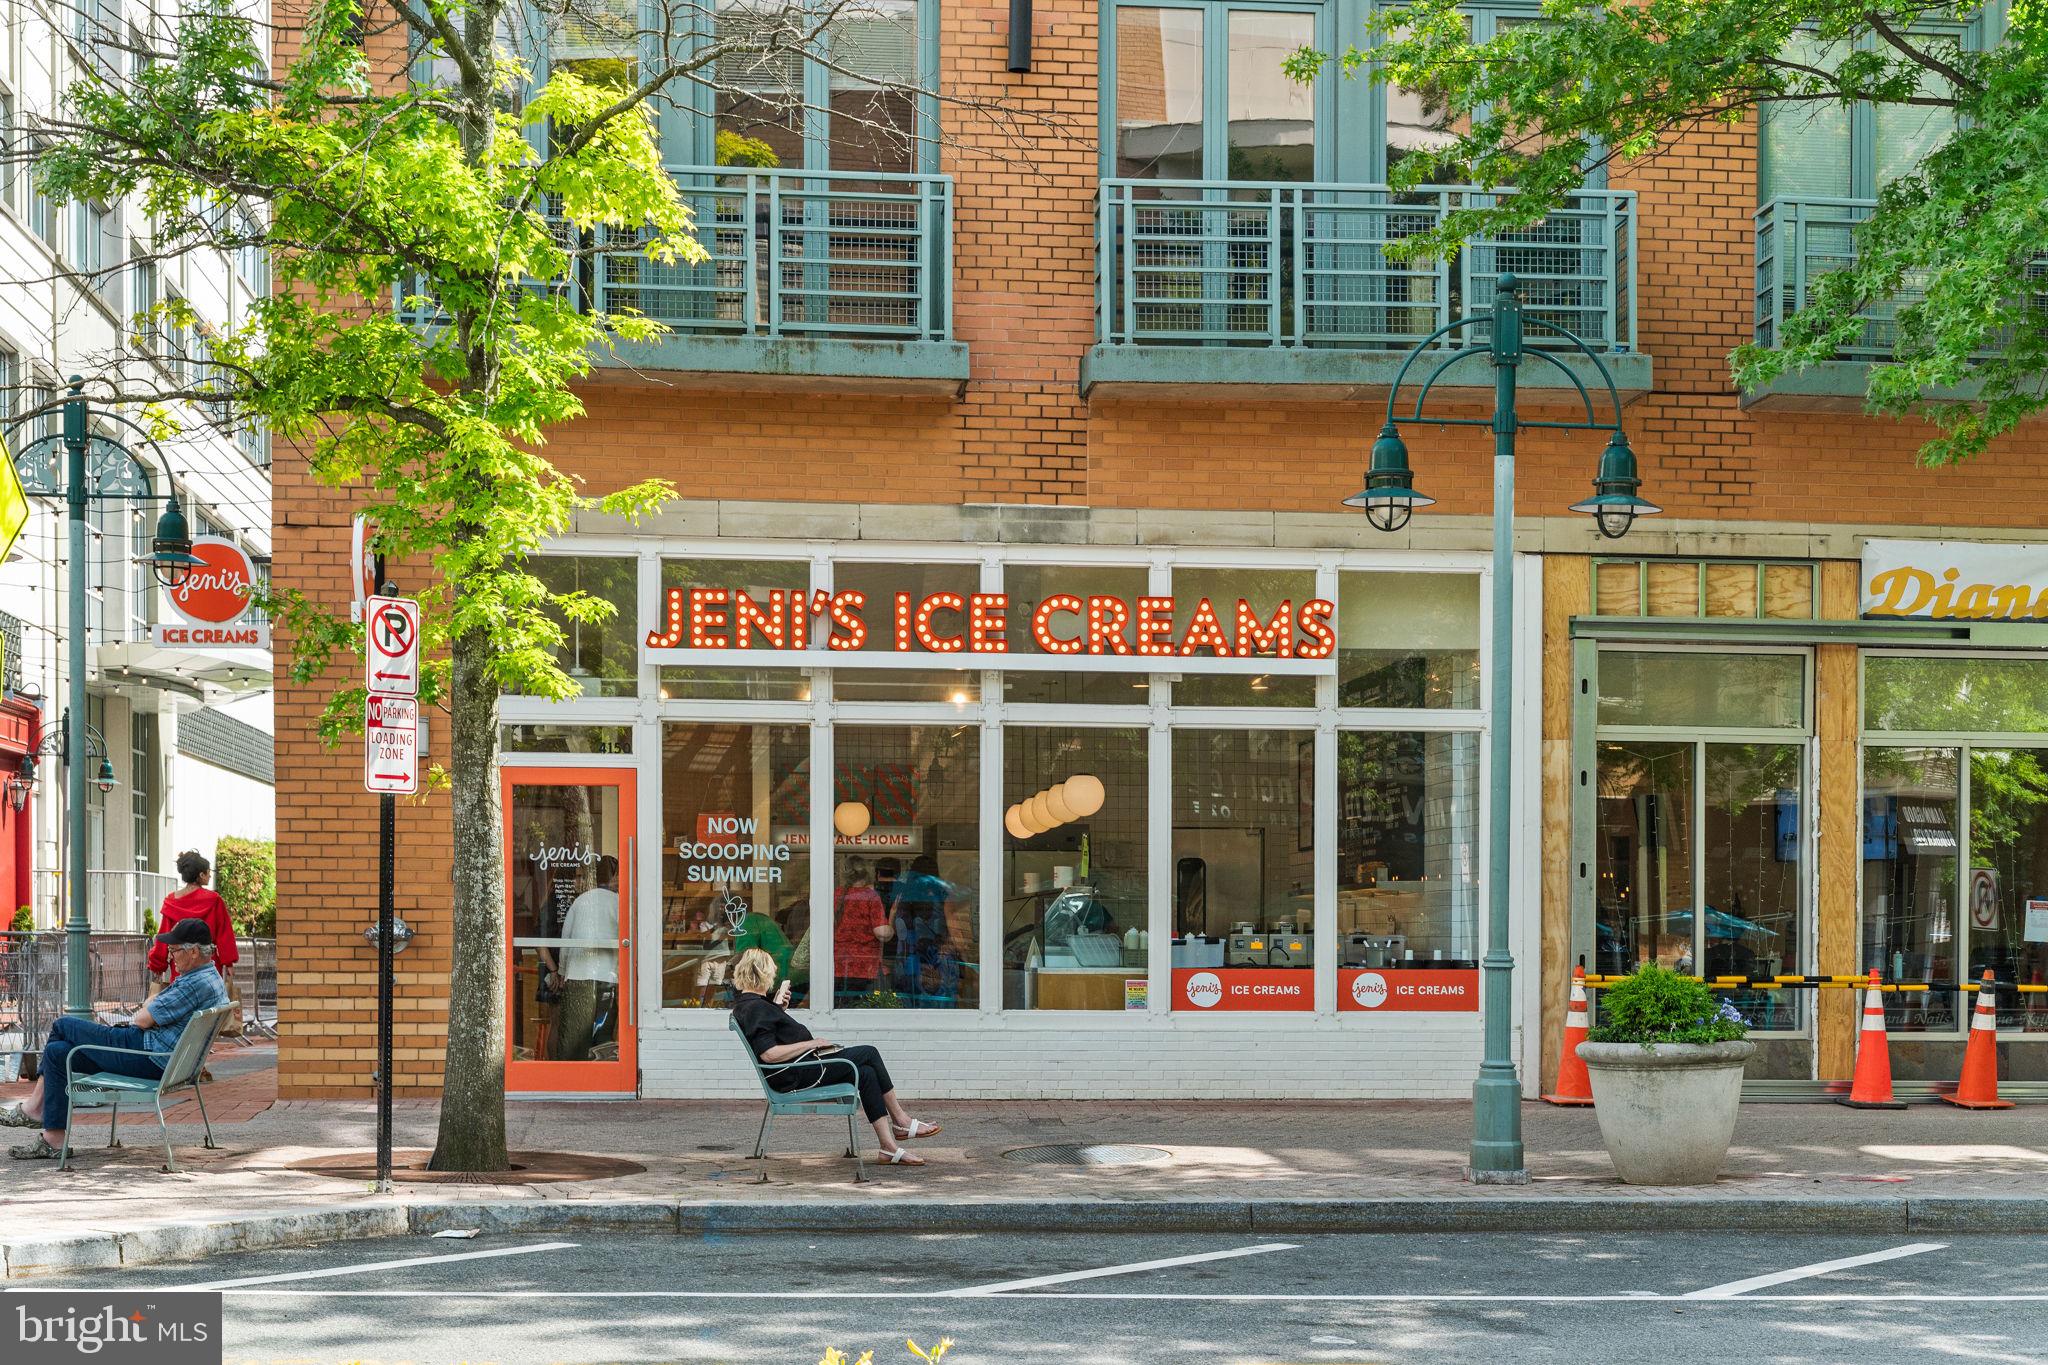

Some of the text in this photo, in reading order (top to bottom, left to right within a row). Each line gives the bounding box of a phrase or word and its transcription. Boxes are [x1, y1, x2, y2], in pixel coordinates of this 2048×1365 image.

[646, 588, 1336, 659] JENI'S ICE CREAMS
[162, 629, 259, 645] ICE CREAMS
[368, 702, 414, 721] NO PARKING
[371, 731, 413, 747] LOADING
[380, 747, 404, 761] ZONE
[600, 742, 631, 754] 4150
[707, 817, 759, 835] NOW
[782, 834, 910, 846] JEN AKE-HOME
[679, 843, 790, 861] SCOOPING
[687, 865, 782, 883] SUMMER
[1187, 982, 1301, 998] jeni's ICE CREAMS
[1352, 982, 1465, 998] jeni's ICE CREAMS
[1914, 1010, 1952, 1025] Nails
